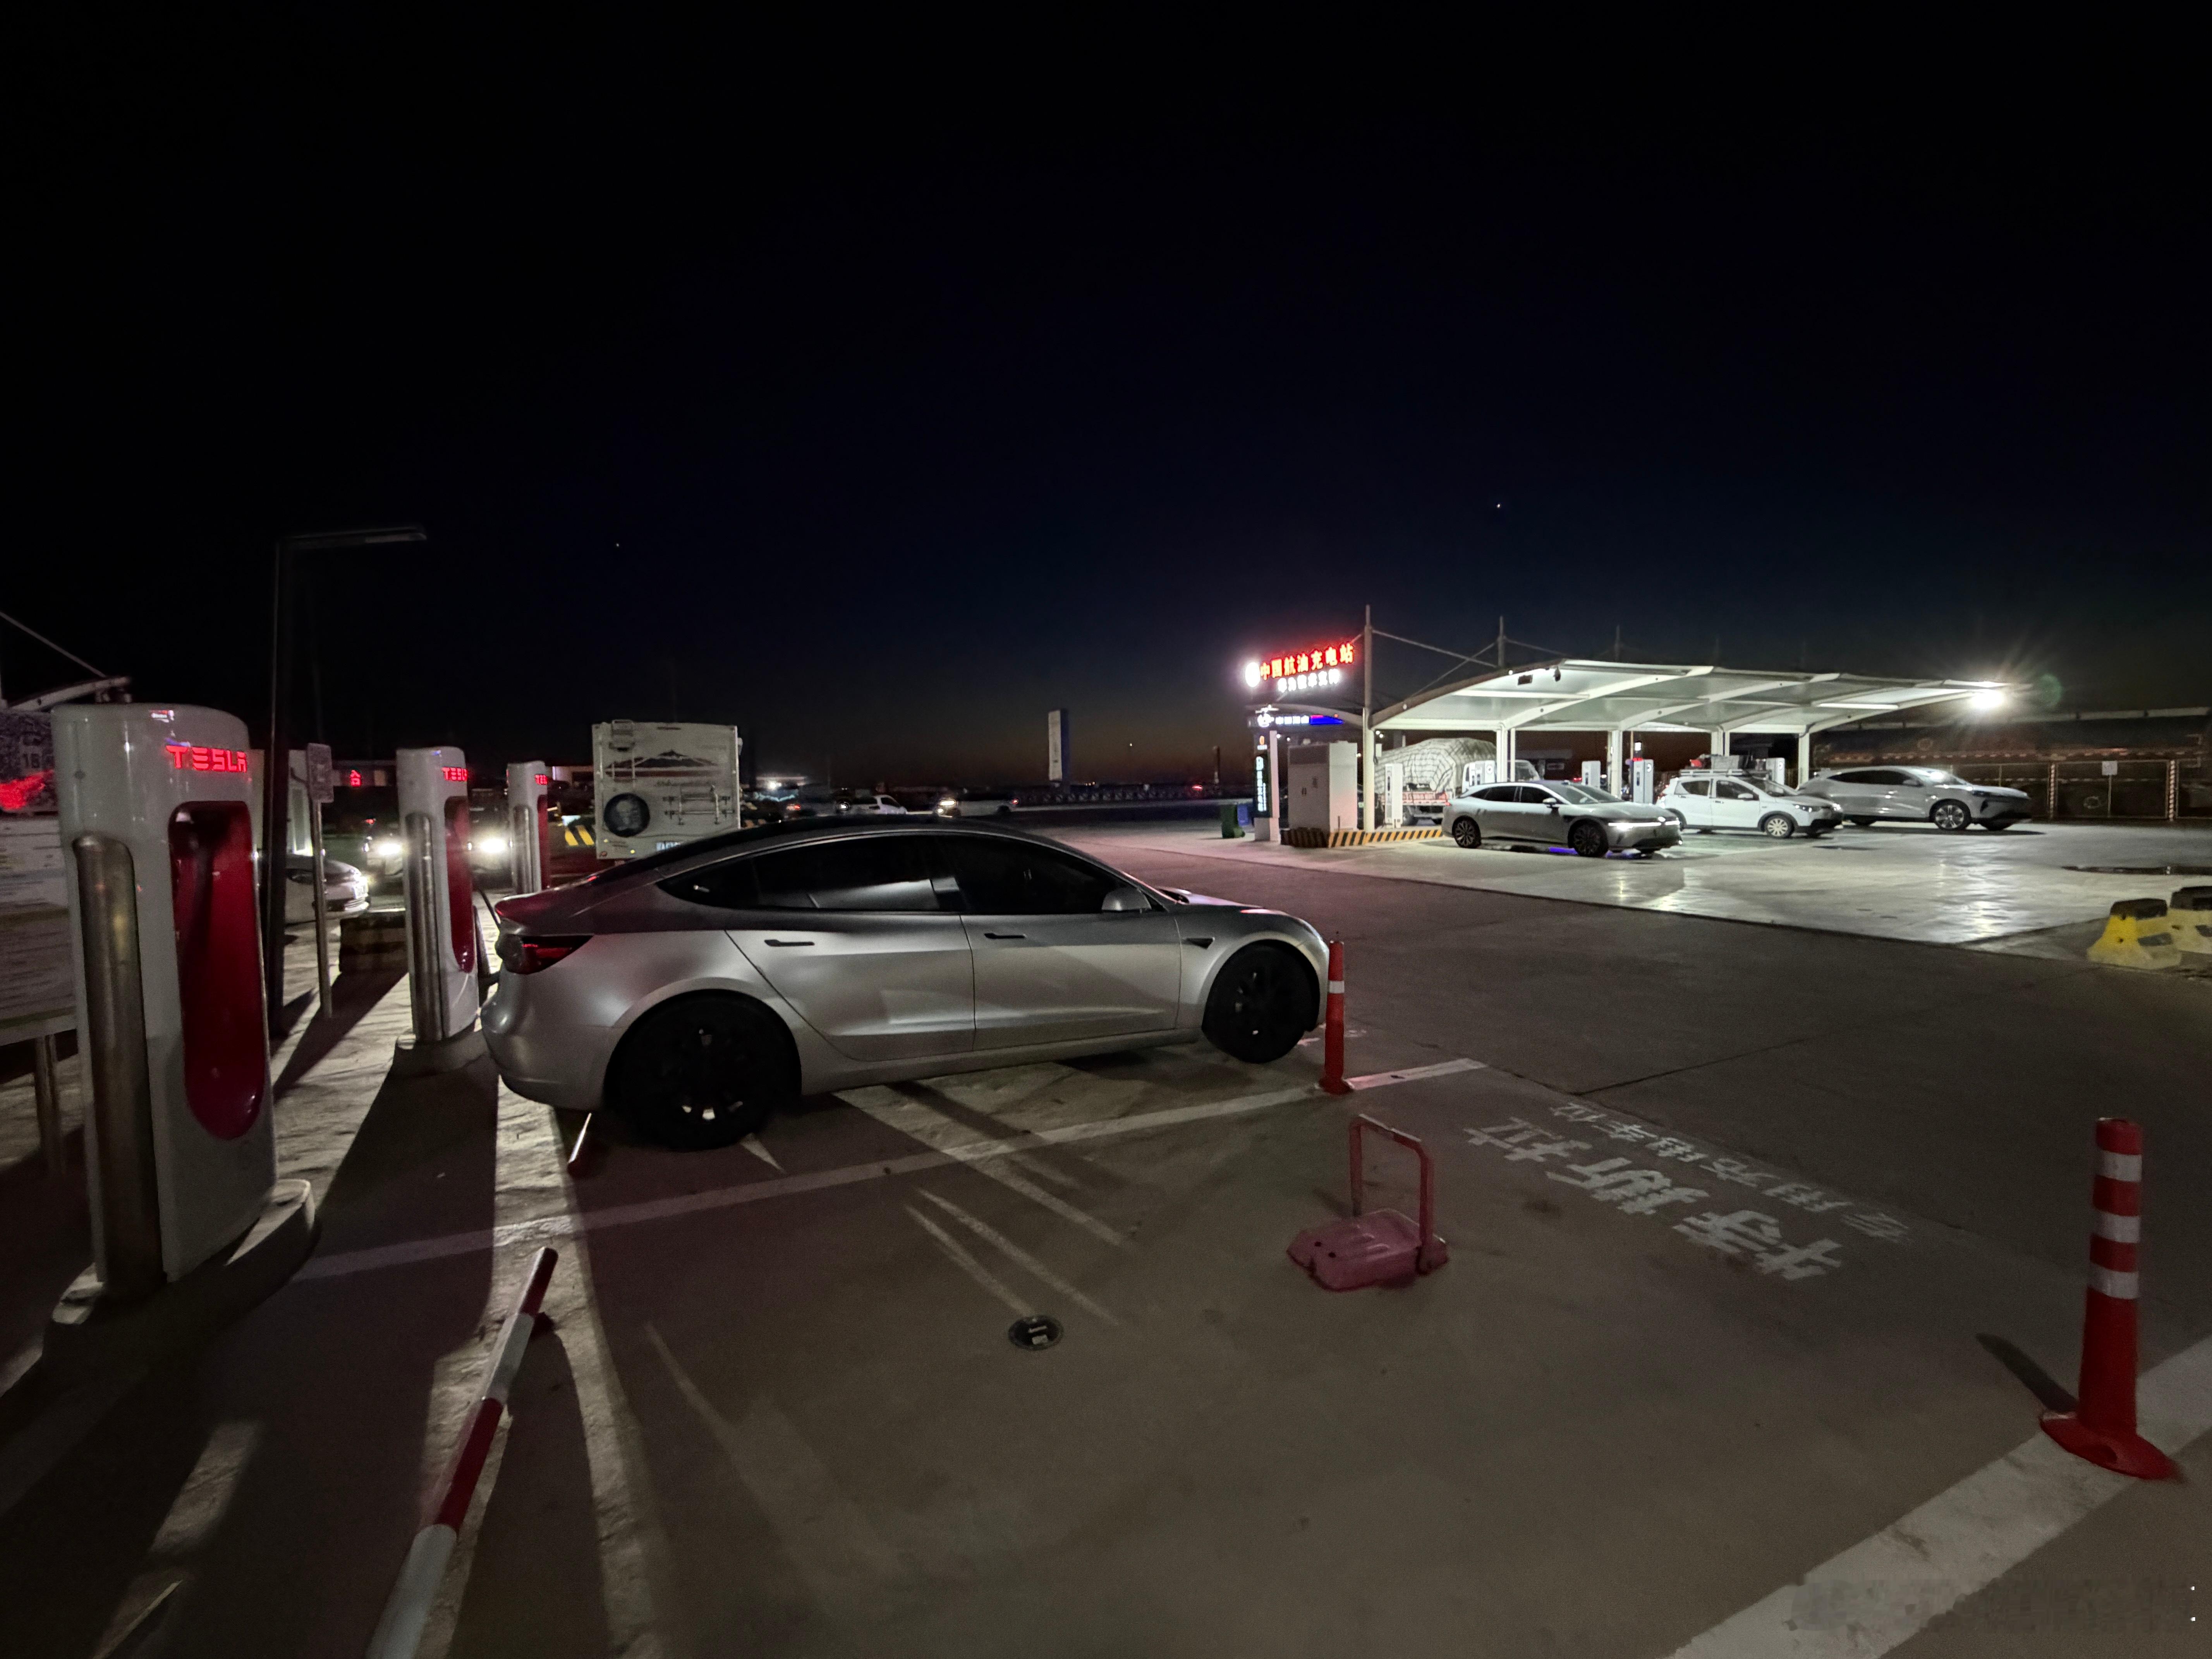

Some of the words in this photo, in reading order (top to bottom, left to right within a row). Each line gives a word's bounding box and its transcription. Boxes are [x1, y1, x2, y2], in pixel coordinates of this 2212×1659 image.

[1260, 643, 1354, 680] 中国航油充电站
[166, 745, 247, 773] TESLA
[1463, 1116, 1842, 1281] 特斯拉
[1550, 1102, 1909, 1239] 专用充电车位
